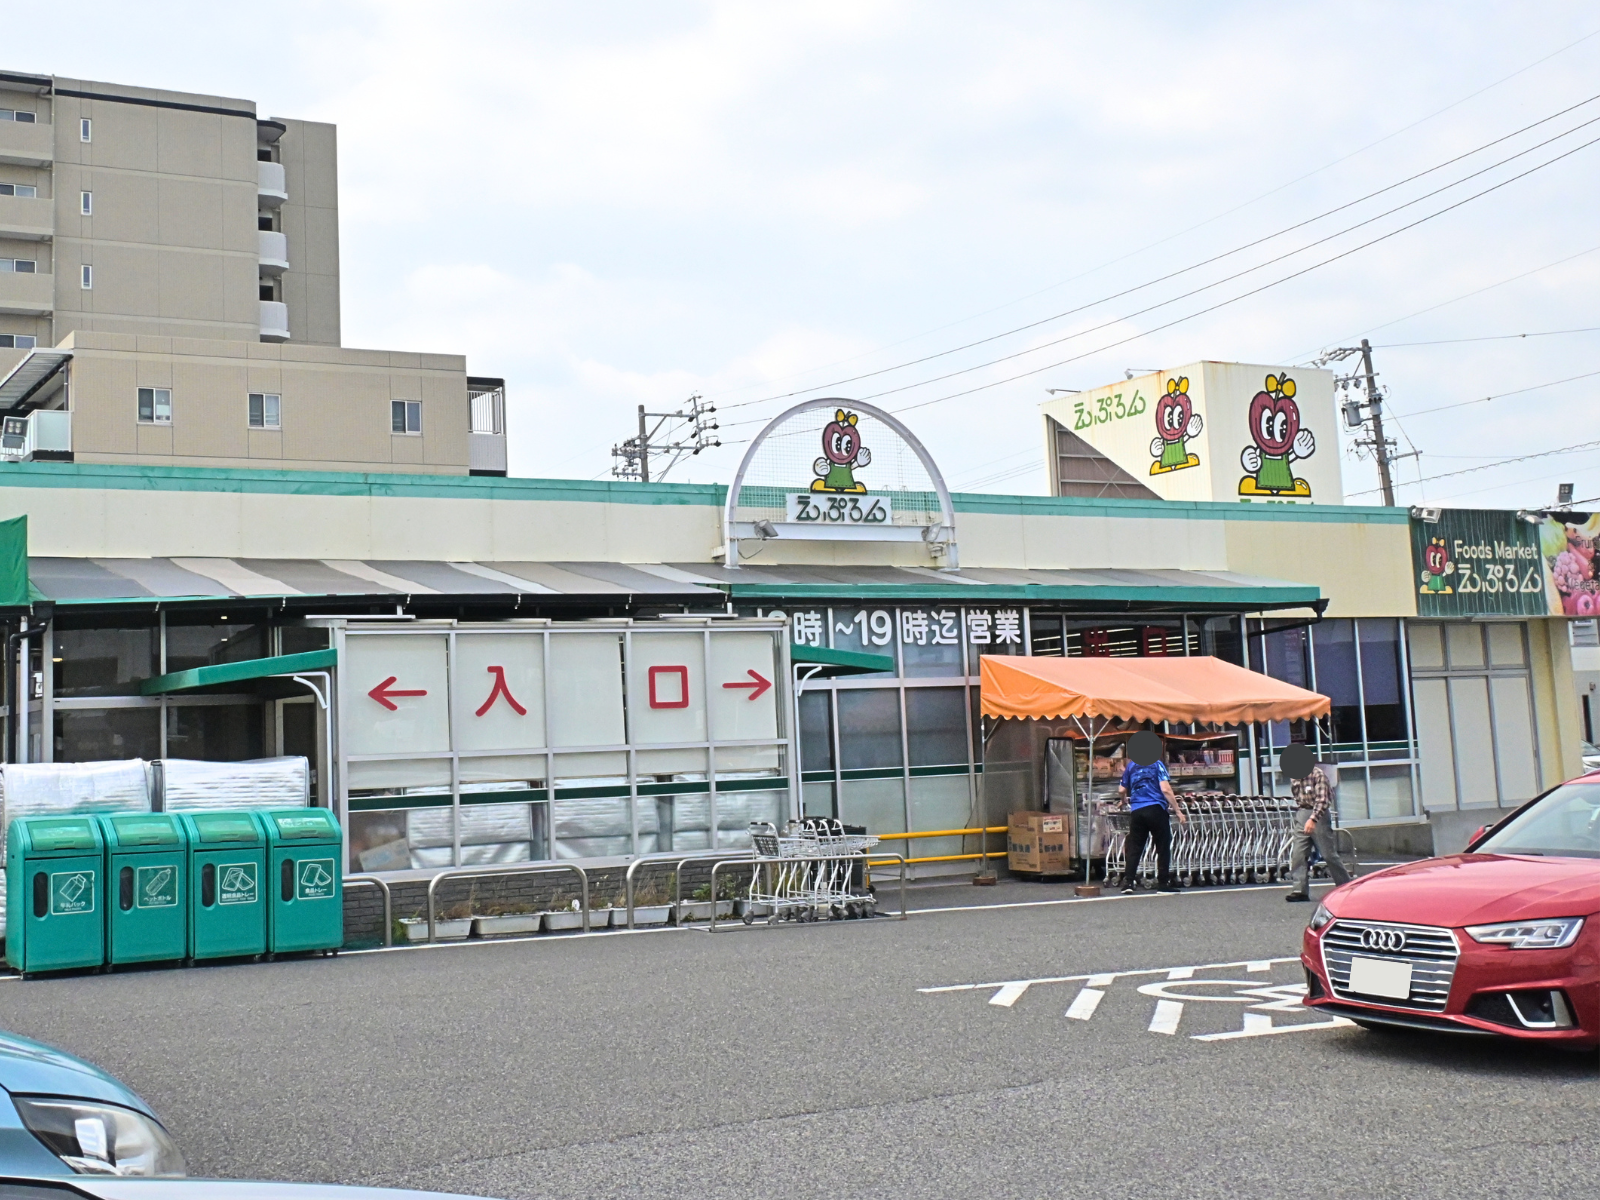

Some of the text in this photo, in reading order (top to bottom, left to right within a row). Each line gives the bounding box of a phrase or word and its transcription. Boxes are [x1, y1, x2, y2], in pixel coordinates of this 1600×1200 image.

[1074, 389, 1146, 430] えぷろん
[796, 495, 887, 522] えぷろん
[1454, 540, 1538, 559] Foods Market
[1458, 563, 1541, 593] えぷろん
[475, 665, 689, 717] 入口
